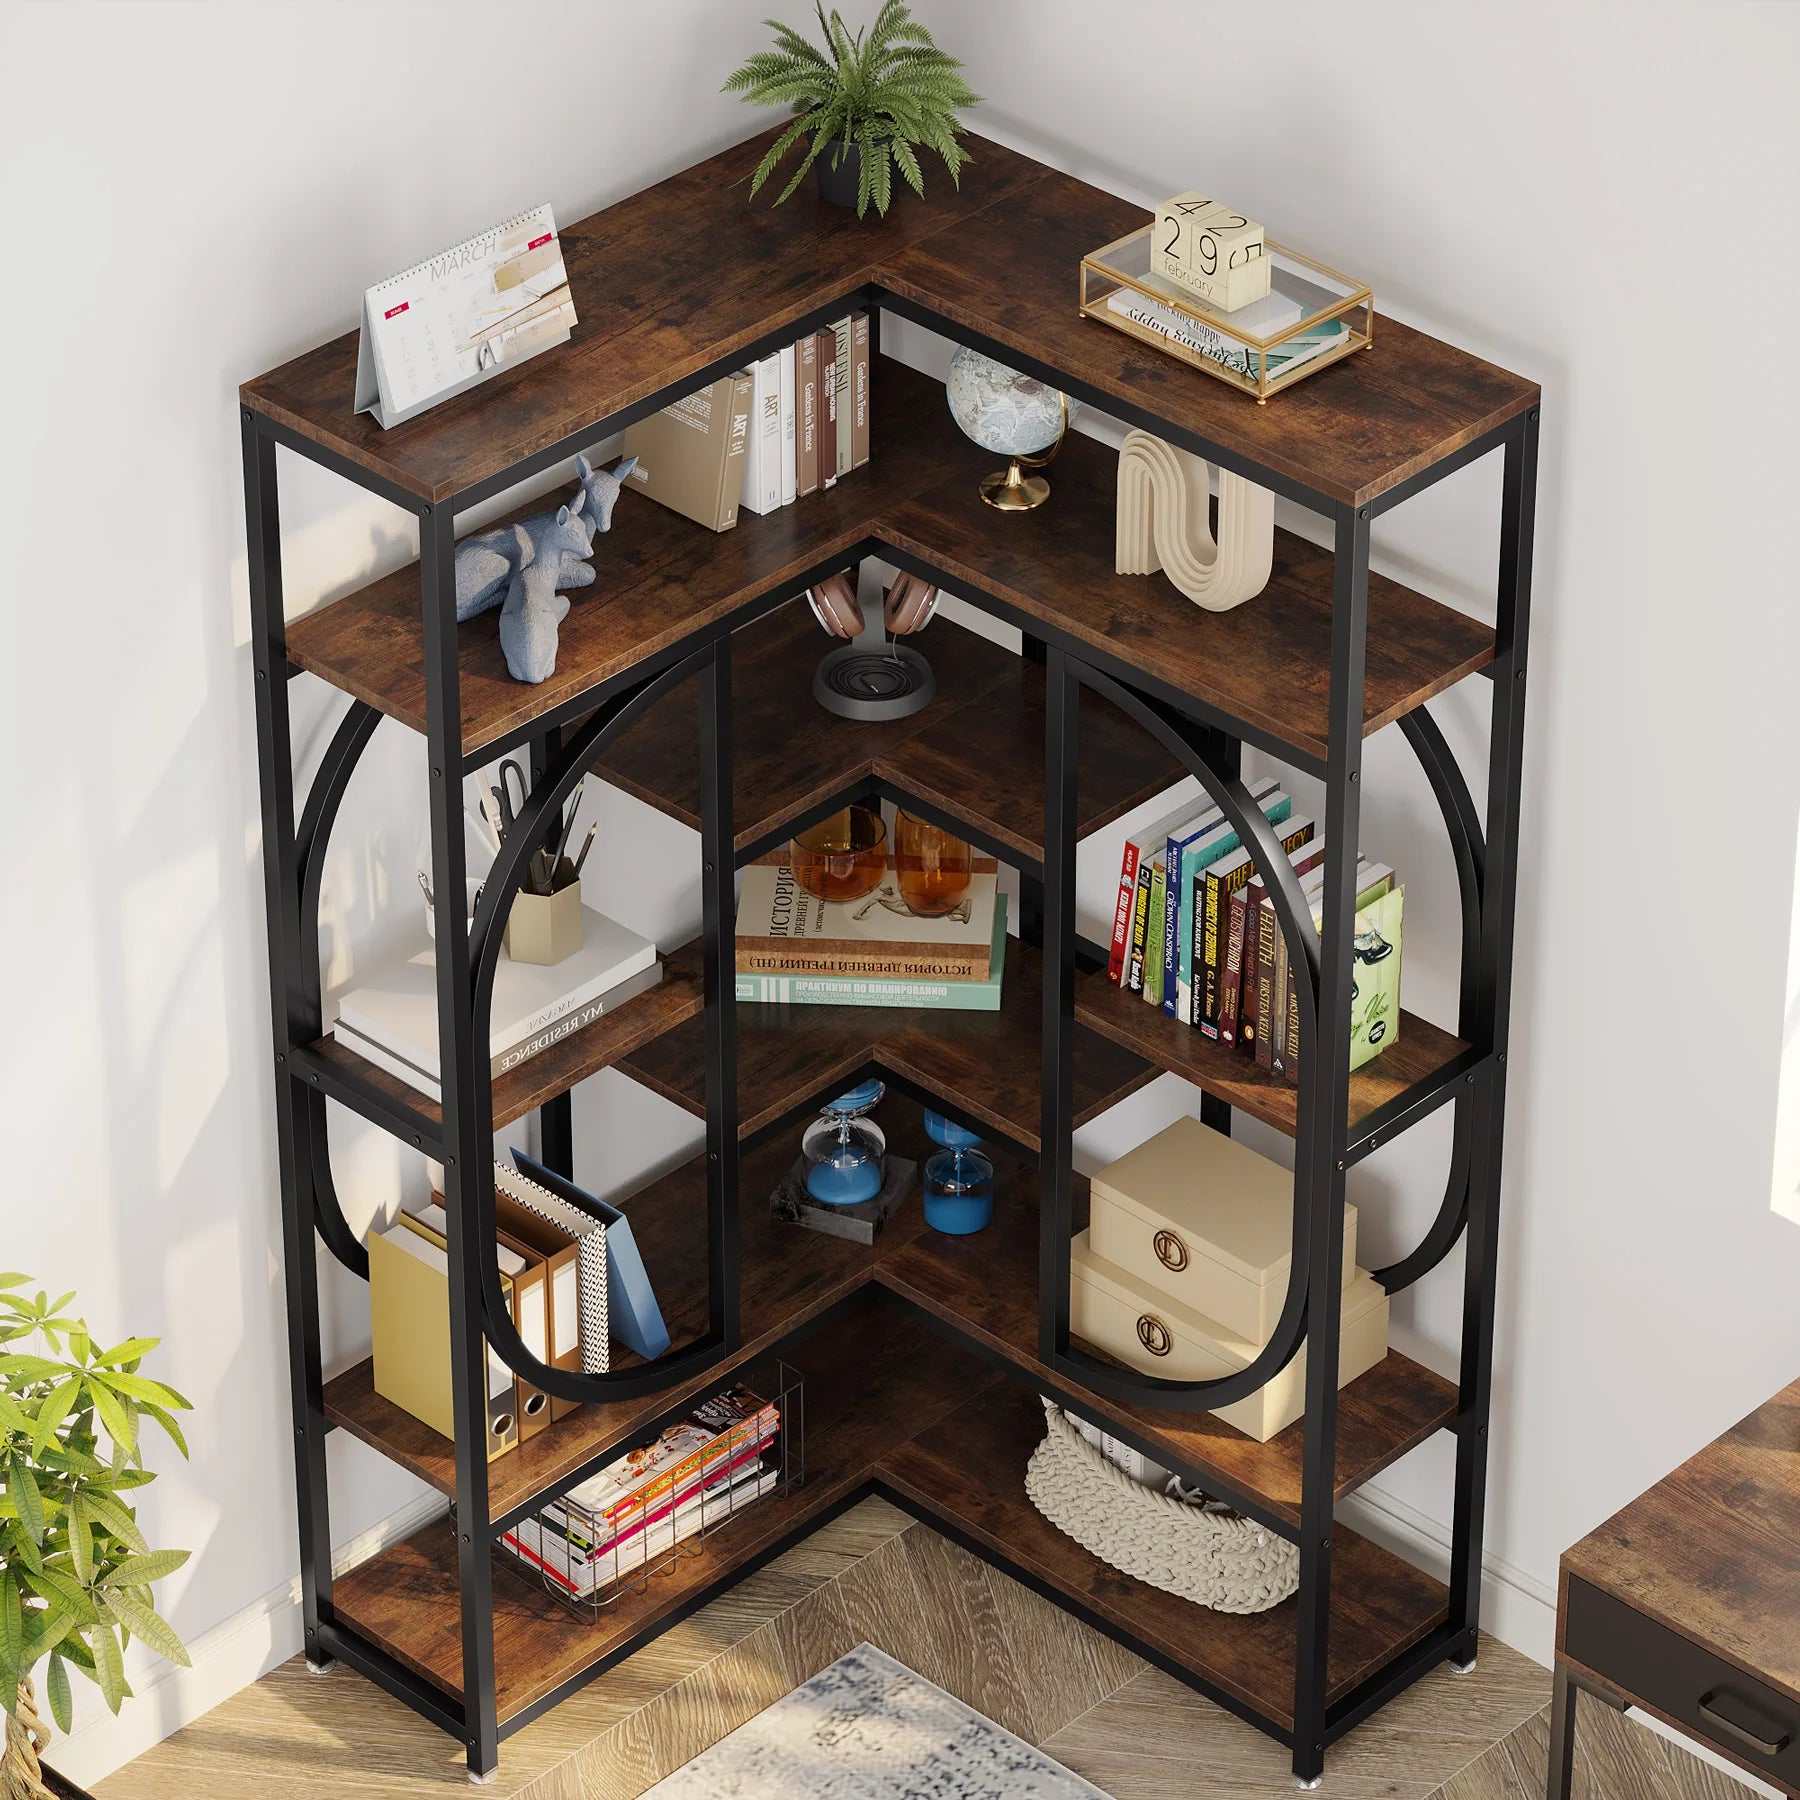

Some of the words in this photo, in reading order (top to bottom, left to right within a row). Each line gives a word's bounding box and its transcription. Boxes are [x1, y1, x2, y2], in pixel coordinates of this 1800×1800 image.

[430, 237, 496, 282] MARCH
[1164, 258, 1213, 297] february
[1126, 308, 1169, 337] happy
[857, 361, 866, 393] Gardens
[764, 394, 778, 419] ART
[804, 382, 814, 415] Gardens
[732, 414, 748, 437] ART
[857, 401, 865, 428] France
[804, 424, 814, 453] France
[1206, 875, 1218, 890] THE
[1225, 865, 1247, 892] THE
[769, 866, 795, 937] ИСТОРИЯ
[1206, 888, 1218, 923] PROPHECY
[794, 901, 809, 937] ДРЕВНЕЙ
[1133, 922, 1144, 949] DEATH
[1226, 904, 1244, 975] GEOSYNCHRON
[1259, 911, 1274, 967] HALITH
[780, 958, 834, 971] ГРЕЦИИ
[839, 961, 901, 973] ДРЕВНЕЙ
[904, 964, 972, 976] ИСТОРИЯ
[1206, 970, 1215, 981] G.
[795, 981, 851, 993] ПРАКТИКУМ
[853, 983, 867, 993] ПО
[868, 984, 947, 996] ПЛАНИРОВАНИЮ
[1260, 976, 1270, 1015] KIRSTEN
[1289, 992, 1299, 1027] KIRSTEN
[1259, 1013, 1269, 1044] KELLY
[1288, 1025, 1299, 1060] KELLY
